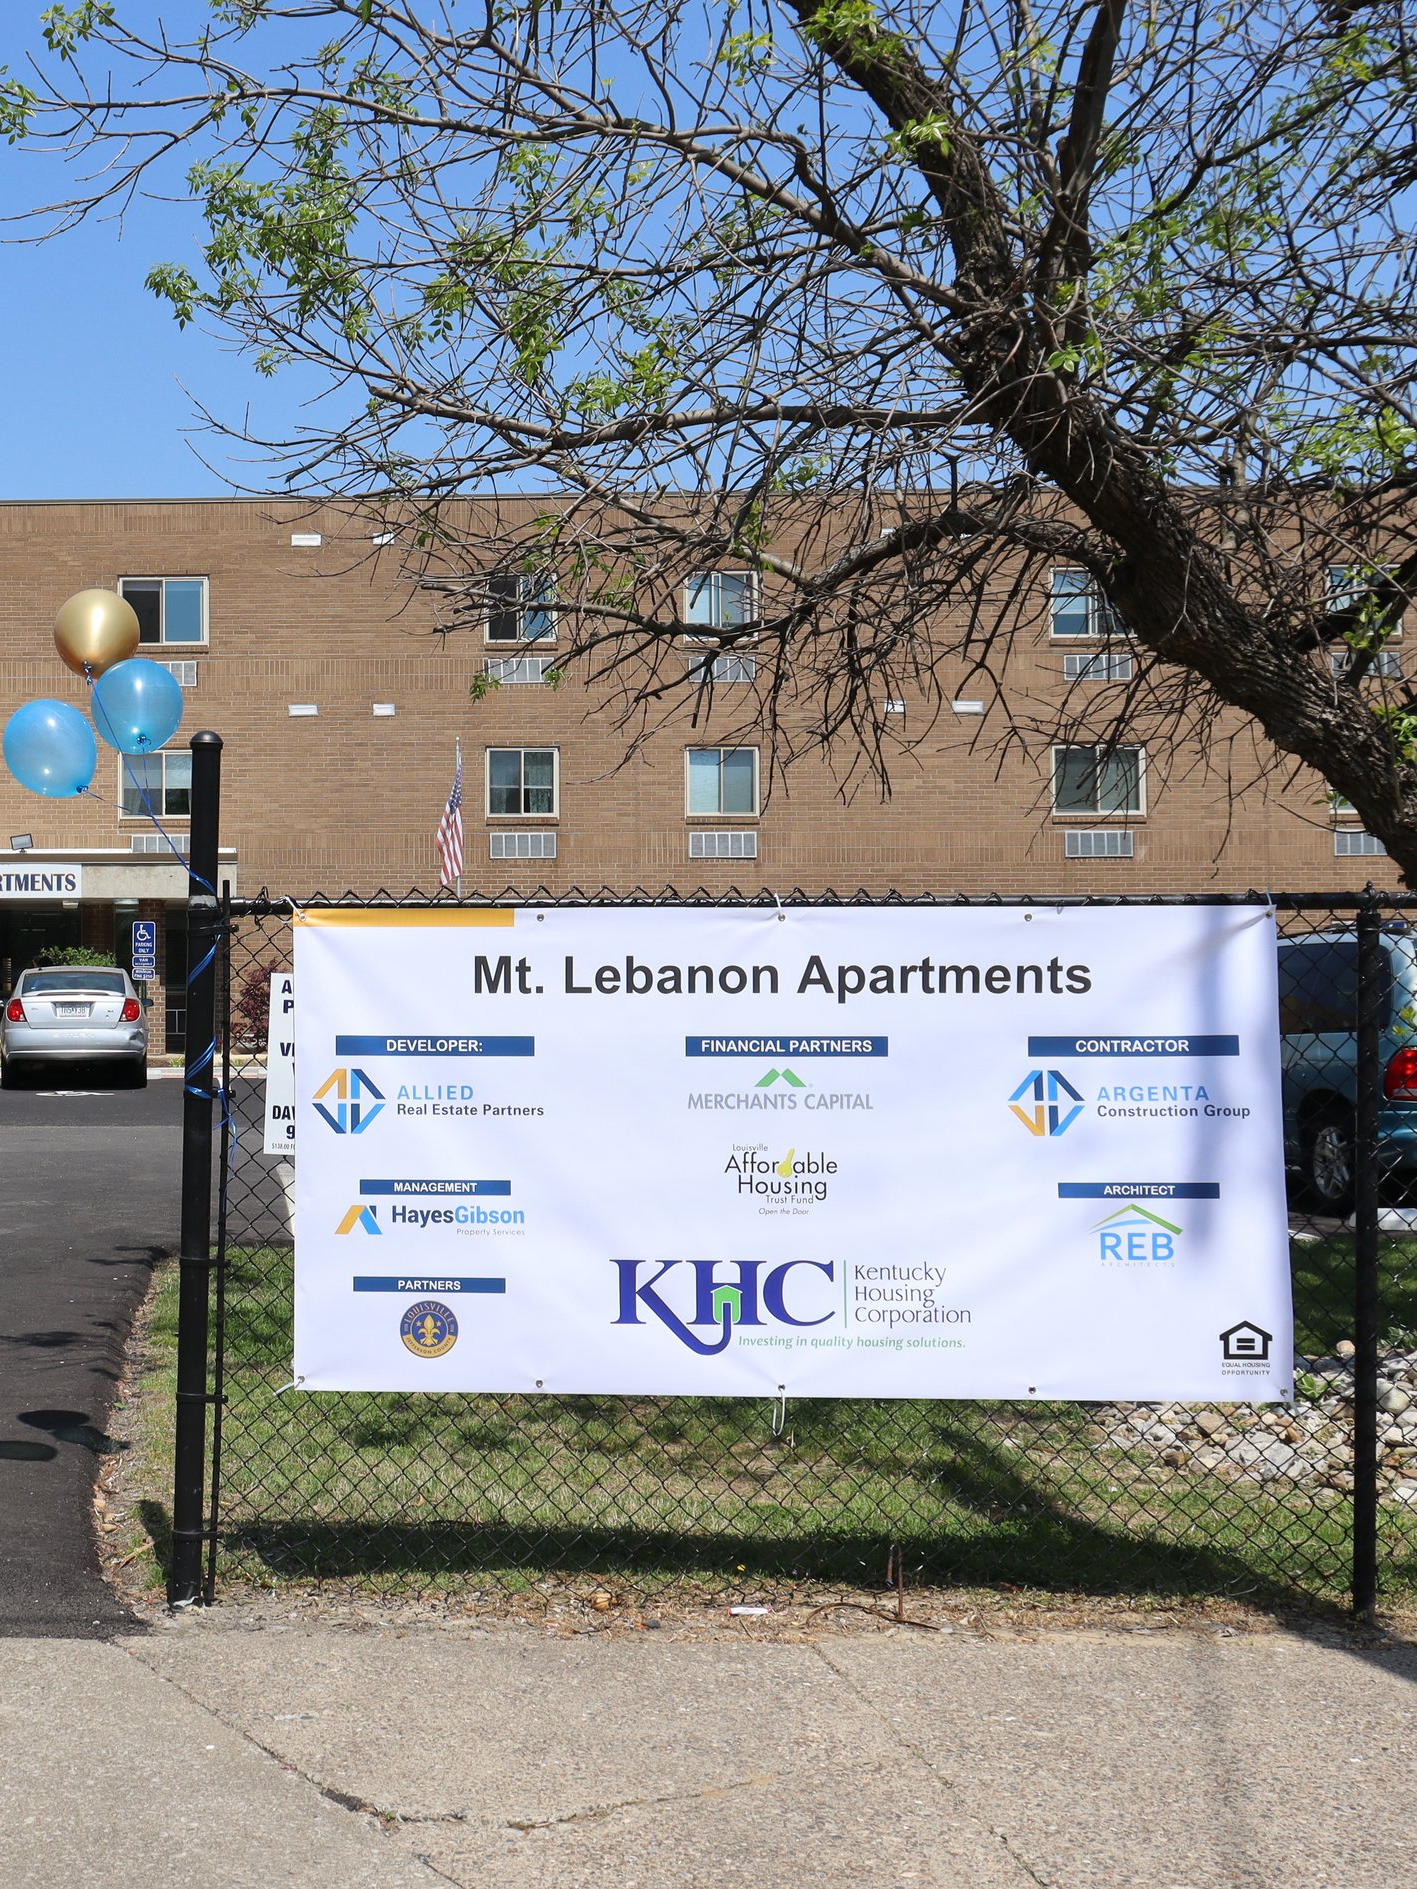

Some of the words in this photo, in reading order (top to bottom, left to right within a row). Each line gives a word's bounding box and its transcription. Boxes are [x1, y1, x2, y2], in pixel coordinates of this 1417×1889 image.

[474, 955, 543, 994] Mt.
[565, 955, 778, 994] Lebanon
[797, 955, 1092, 1004] Apartments
[386, 1039, 483, 1052] DEVELOPER:
[701, 1040, 785, 1053] FINANCIAL
[789, 1040, 873, 1053] PARTNERS
[1075, 1040, 1190, 1053] CONTRACTOR
[397, 1085, 474, 1100] ALLIED
[1097, 1086, 1210, 1101] ARGENTA
[687, 1093, 797, 1110] MERCHANTS
[804, 1093, 873, 1110] CAPITAL
[397, 1104, 427, 1116] Real
[432, 1104, 478, 1116] Estate
[483, 1104, 544, 1116] Partners
[1097, 1105, 1199, 1118] Construction
[1204, 1104, 1251, 1119] Group
[393, 1182, 478, 1193] MANAGEMENT
[738, 1174, 827, 1201] Housing
[1103, 1185, 1175, 1196] ARCHITECT
[766, 1195, 787, 1204] Trust
[791, 1195, 814, 1204] Fund
[392, 1205, 525, 1228] HayesGibson
[456, 1228, 490, 1236] Property
[1100, 1232, 1175, 1261] REB
[854, 1261, 947, 1287] Kentucky
[397, 1280, 462, 1291] PARTNERS
[854, 1284, 936, 1307] Housing
[609, 1259, 836, 1356] KHC
[854, 1305, 972, 1329] Corporation
[738, 1335, 793, 1349] Investing
[796, 1336, 808, 1347] in
[810, 1336, 853, 1350] quality
[856, 1337, 903, 1350] housing
[906, 1336, 966, 1349] solutions.
